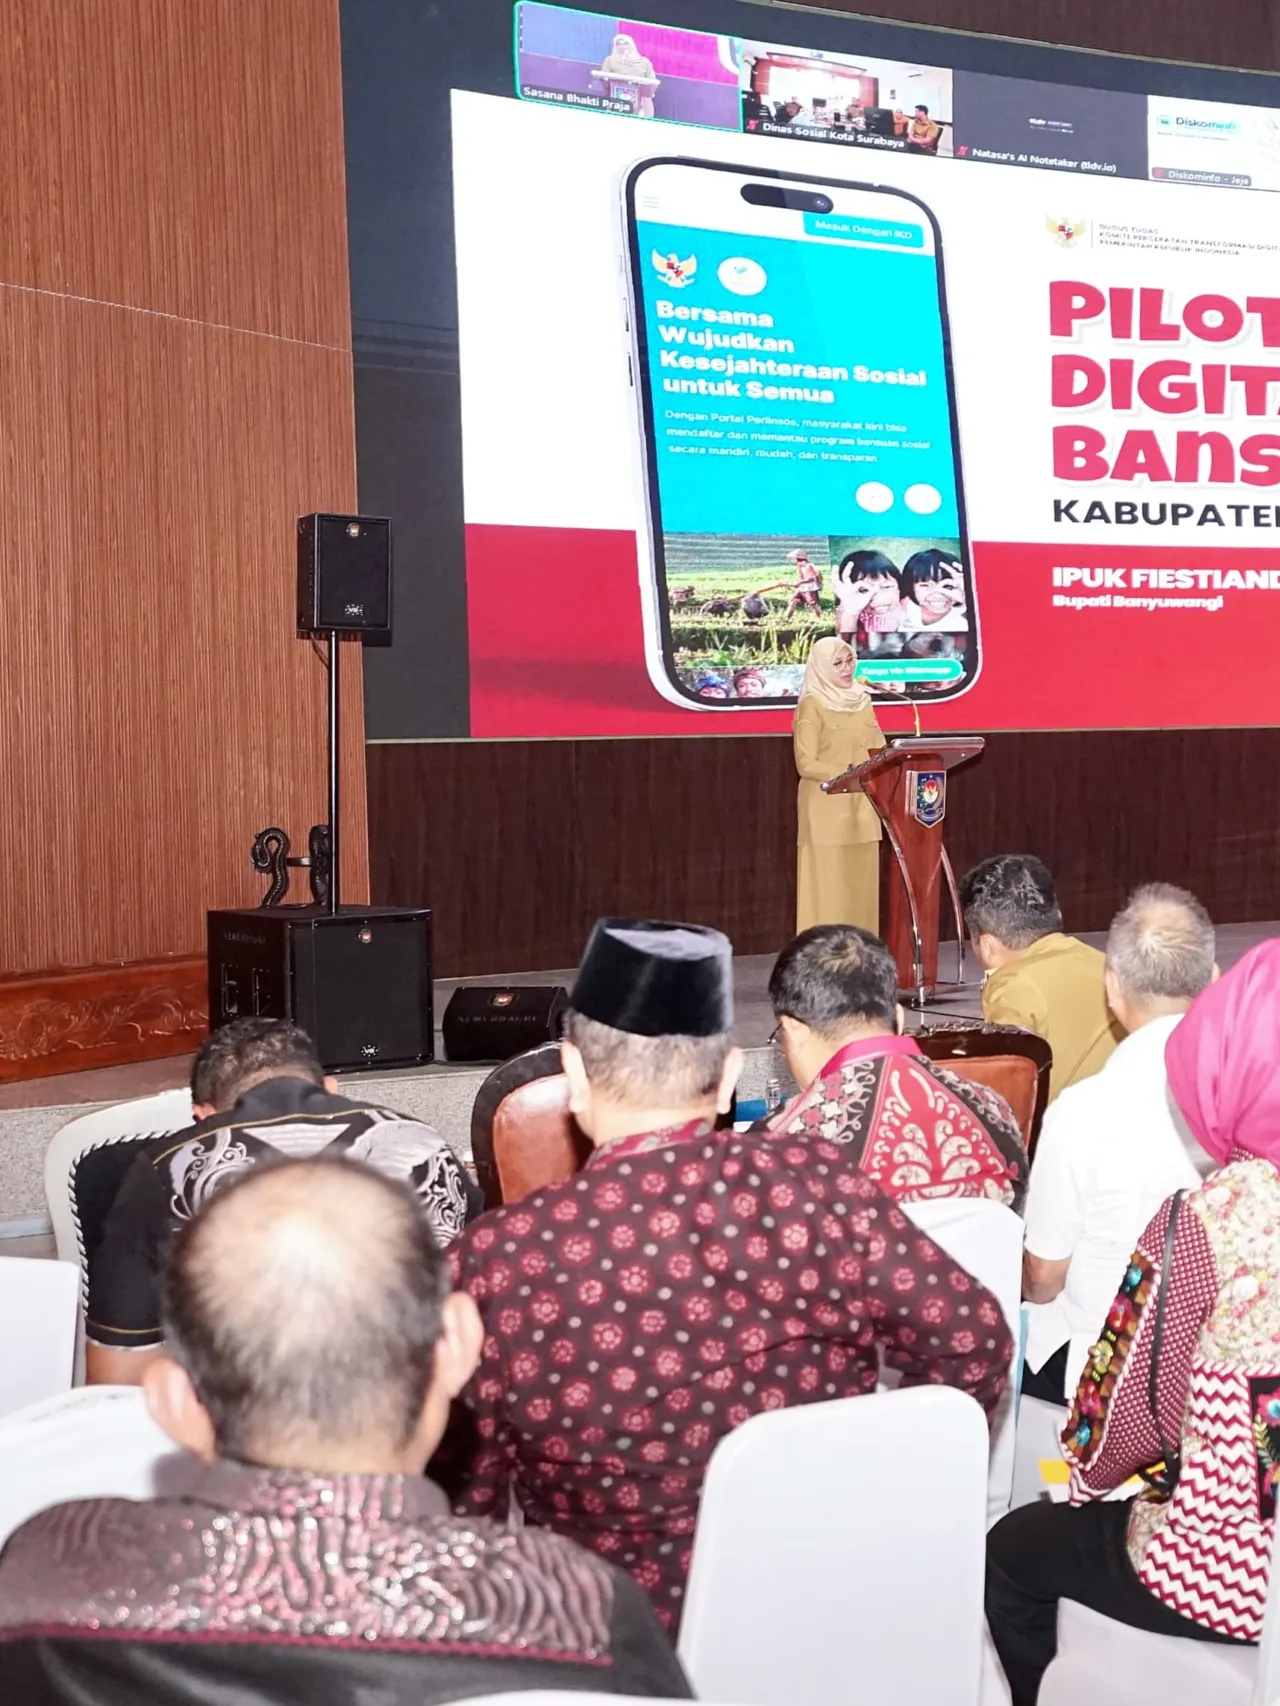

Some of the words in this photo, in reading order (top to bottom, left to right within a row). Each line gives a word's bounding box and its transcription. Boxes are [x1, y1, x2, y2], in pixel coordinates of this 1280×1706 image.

[523, 87, 563, 100] Sasana
[566, 94, 600, 107] Bhakti
[602, 99, 631, 112] Praja
[763, 122, 793, 134] Dinas
[795, 127, 827, 138] Sosial
[829, 131, 854, 142] Kota
[857, 134, 905, 149] Surabaya
[972, 148, 1015, 161] Natasa's
[1030, 154, 1079, 168] Notetaker
[1168, 170, 1221, 182] Diskominfo
[656, 300, 774, 328] Bersama
[658, 325, 795, 354] Wujudkan
[660, 350, 848, 382] Kesejahteraan
[853, 365, 927, 387] Sosial
[663, 376, 741, 398] untuk
[746, 380, 835, 404] Semua
[665, 410, 708, 422] Dengan
[1053, 566, 1127, 589] IPUK
[1053, 595, 1111, 610] Bupati
[1113, 595, 1224, 612] Banyuwangi
